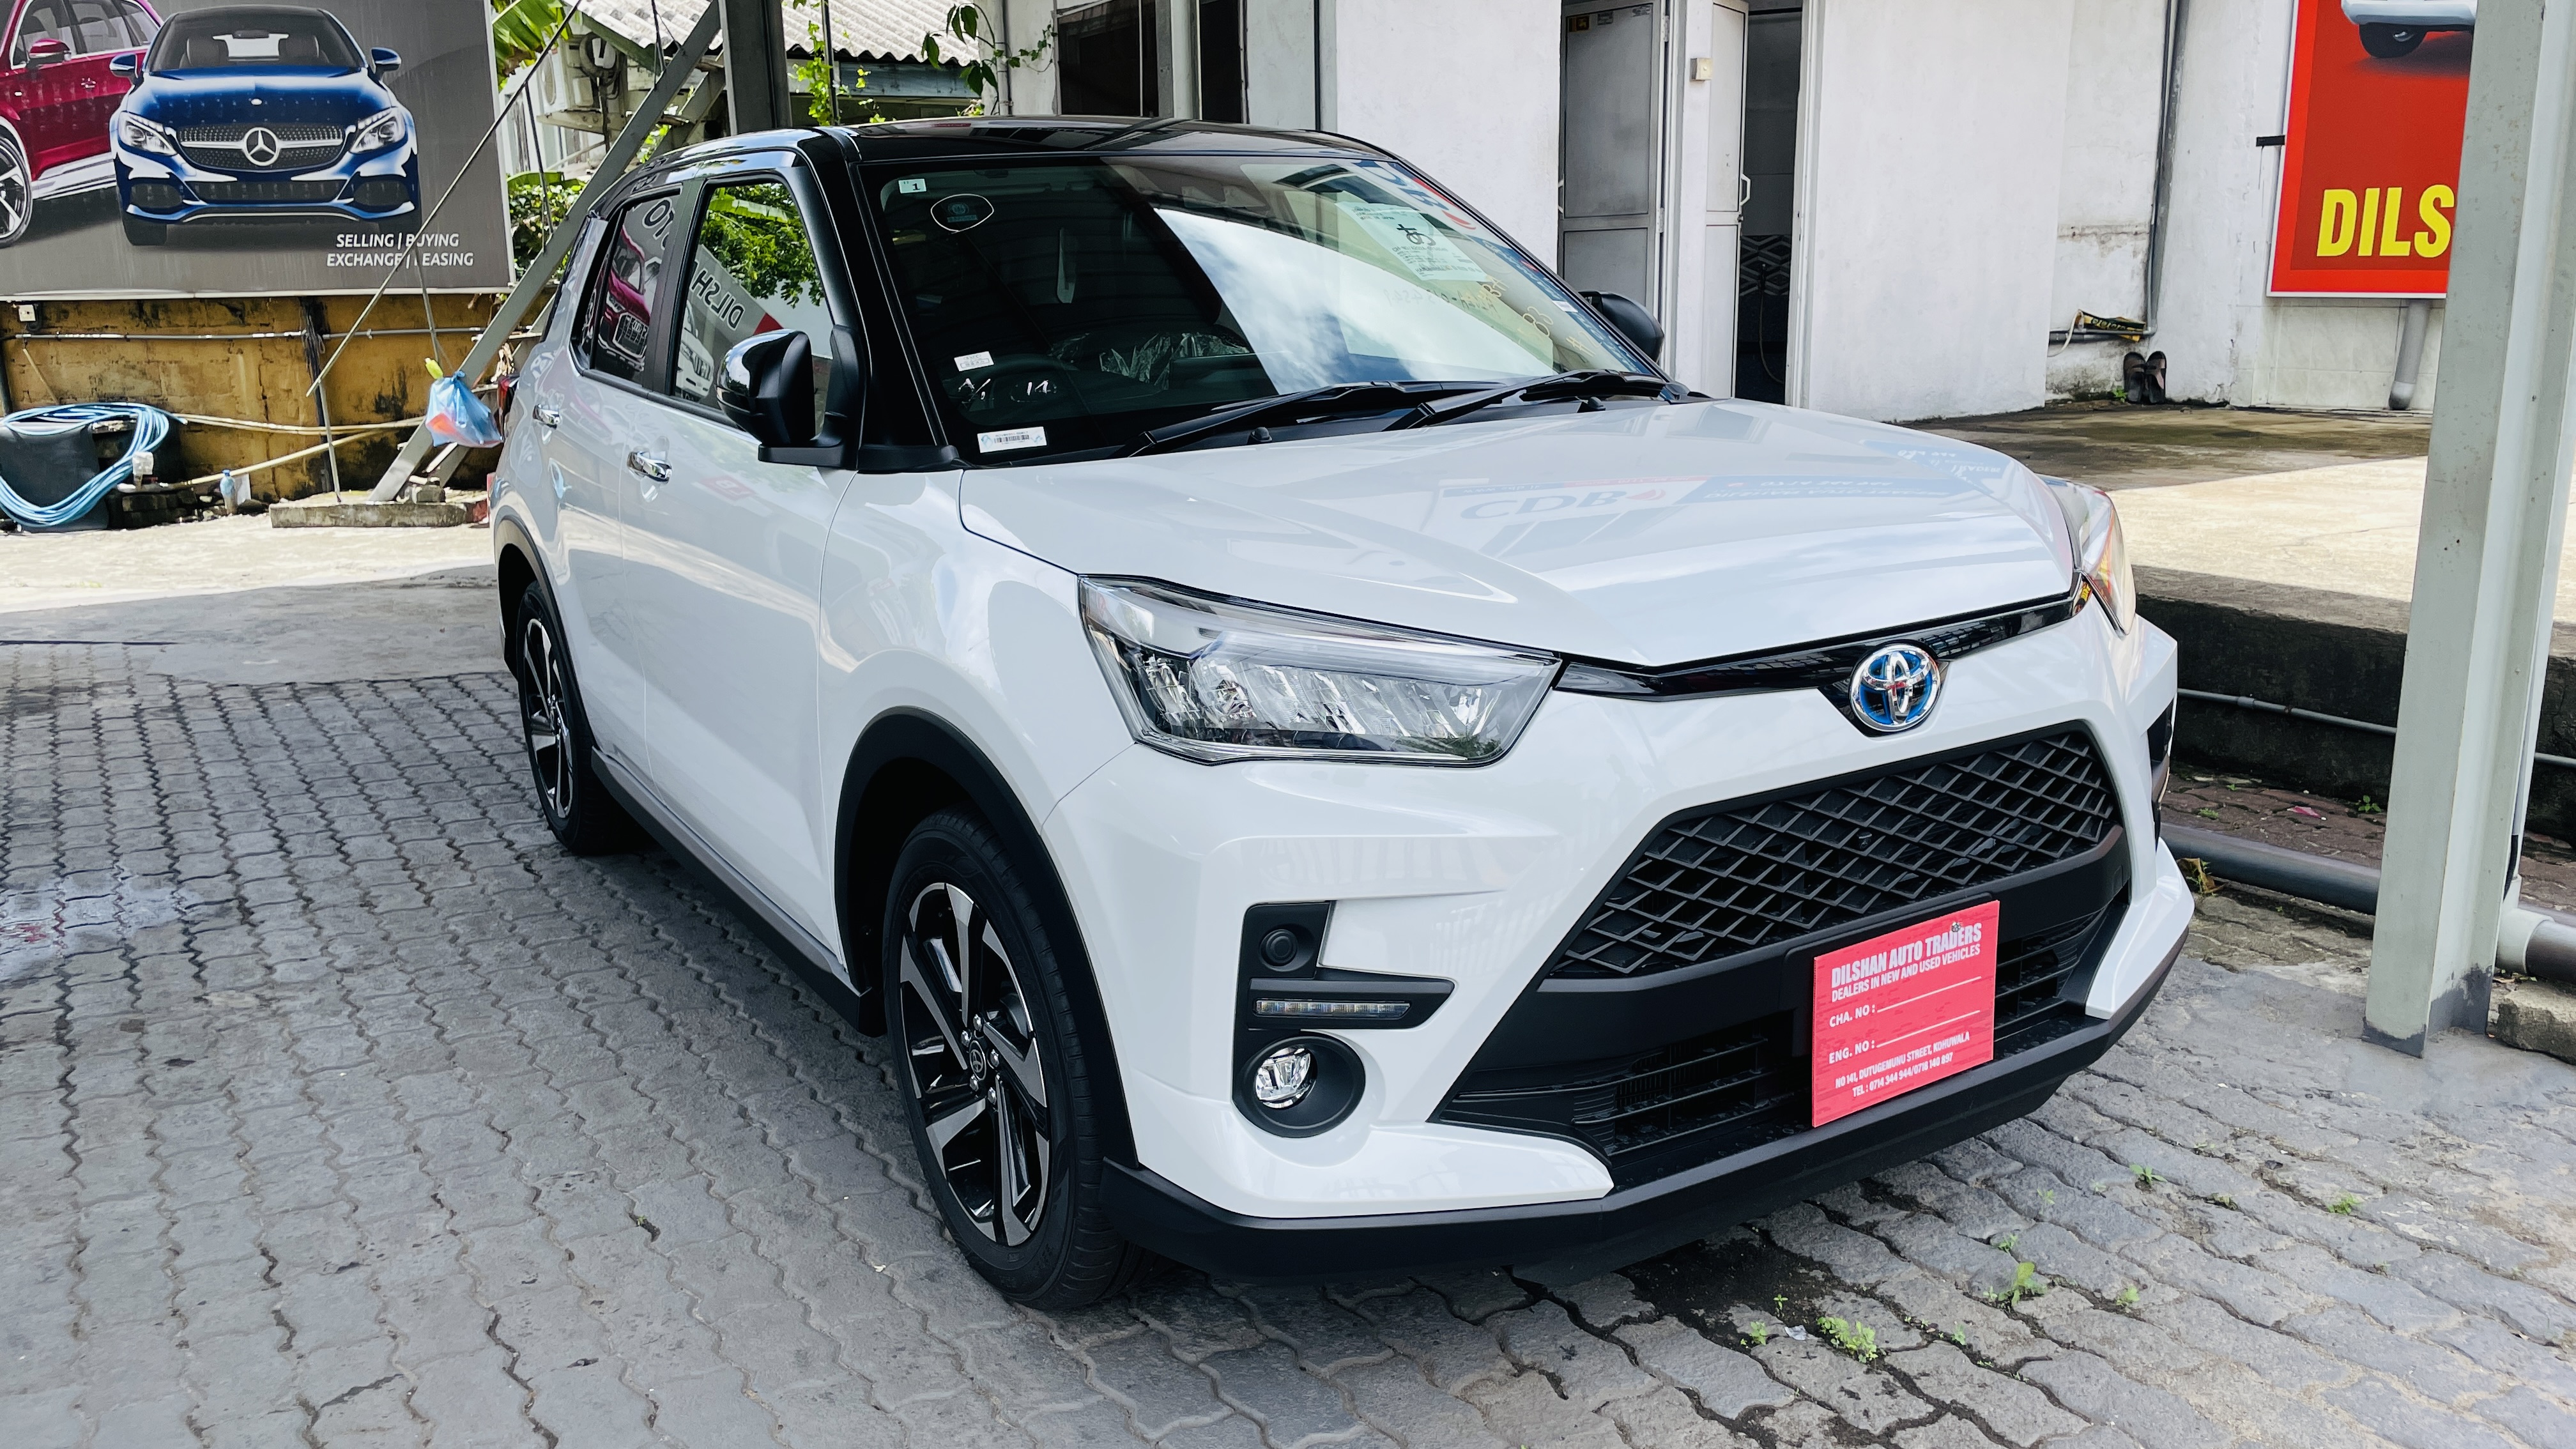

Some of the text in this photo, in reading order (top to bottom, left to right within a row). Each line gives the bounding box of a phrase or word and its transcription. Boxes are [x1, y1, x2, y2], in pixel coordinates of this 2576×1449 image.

[1396, 224, 1436, 247] あ
[2317, 184, 2455, 259] DILS
[336, 233, 394, 248] SELLING
[326, 252, 403, 266] EXCHANGE
[1831, 922, 1982, 988] DILSHAN AUTO TRADERS
[1831, 944, 1981, 1003] DEALERS IN NEW AND USED VEHICLES
[1829, 1012, 1852, 1028] CHA.
[1828, 1047, 1852, 1064] ENG.
[1835, 1077, 1846, 1089] NO
[1859, 1054, 1906, 1080] DUTUGEMUNU
[1906, 1045, 1932, 1062] STREET,
[1933, 1031, 1970, 1052] KOHUWALA
[1869, 1079, 1885, 1091] 0714
[1885, 1075, 1897, 1085] 344
[1929, 1057, 1941, 1069] 140
[1941, 1052, 1954, 1065] 897
